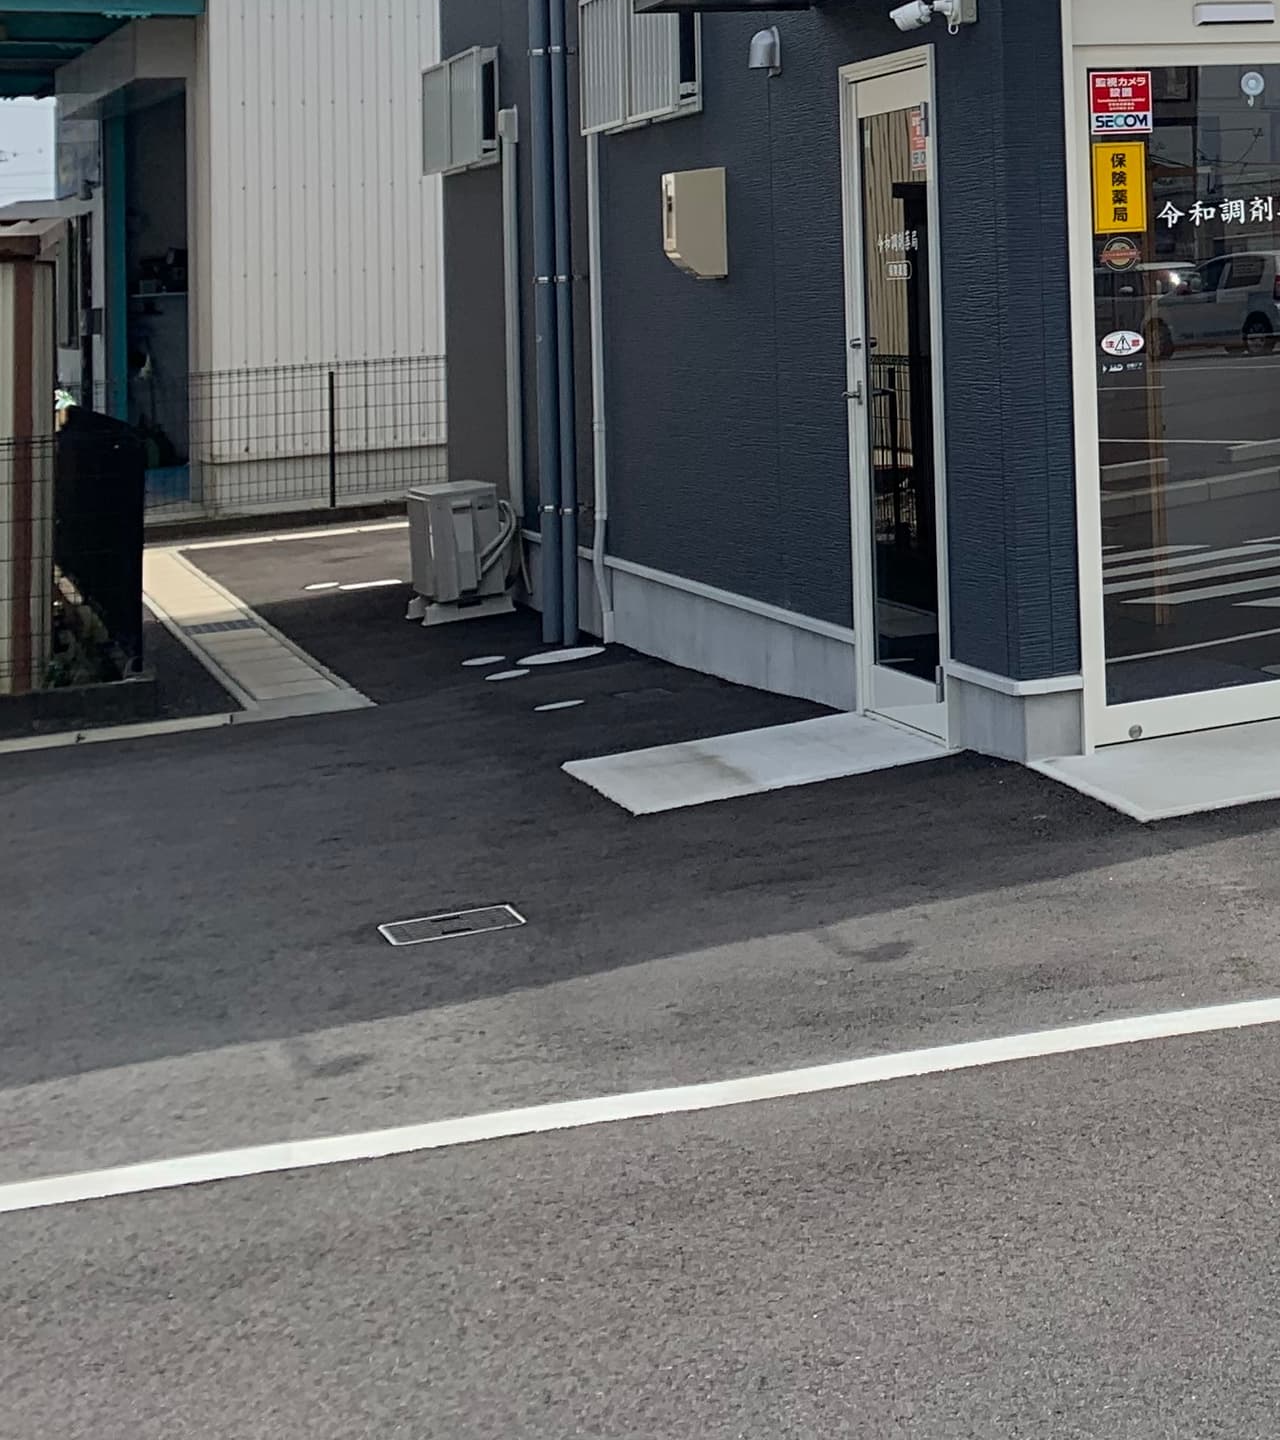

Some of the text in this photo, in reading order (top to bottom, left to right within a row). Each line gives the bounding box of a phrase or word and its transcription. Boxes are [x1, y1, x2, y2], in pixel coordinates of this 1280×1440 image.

[1095, 113, 1149, 129] SECOM
[1110, 152, 1128, 223] 保険薬局
